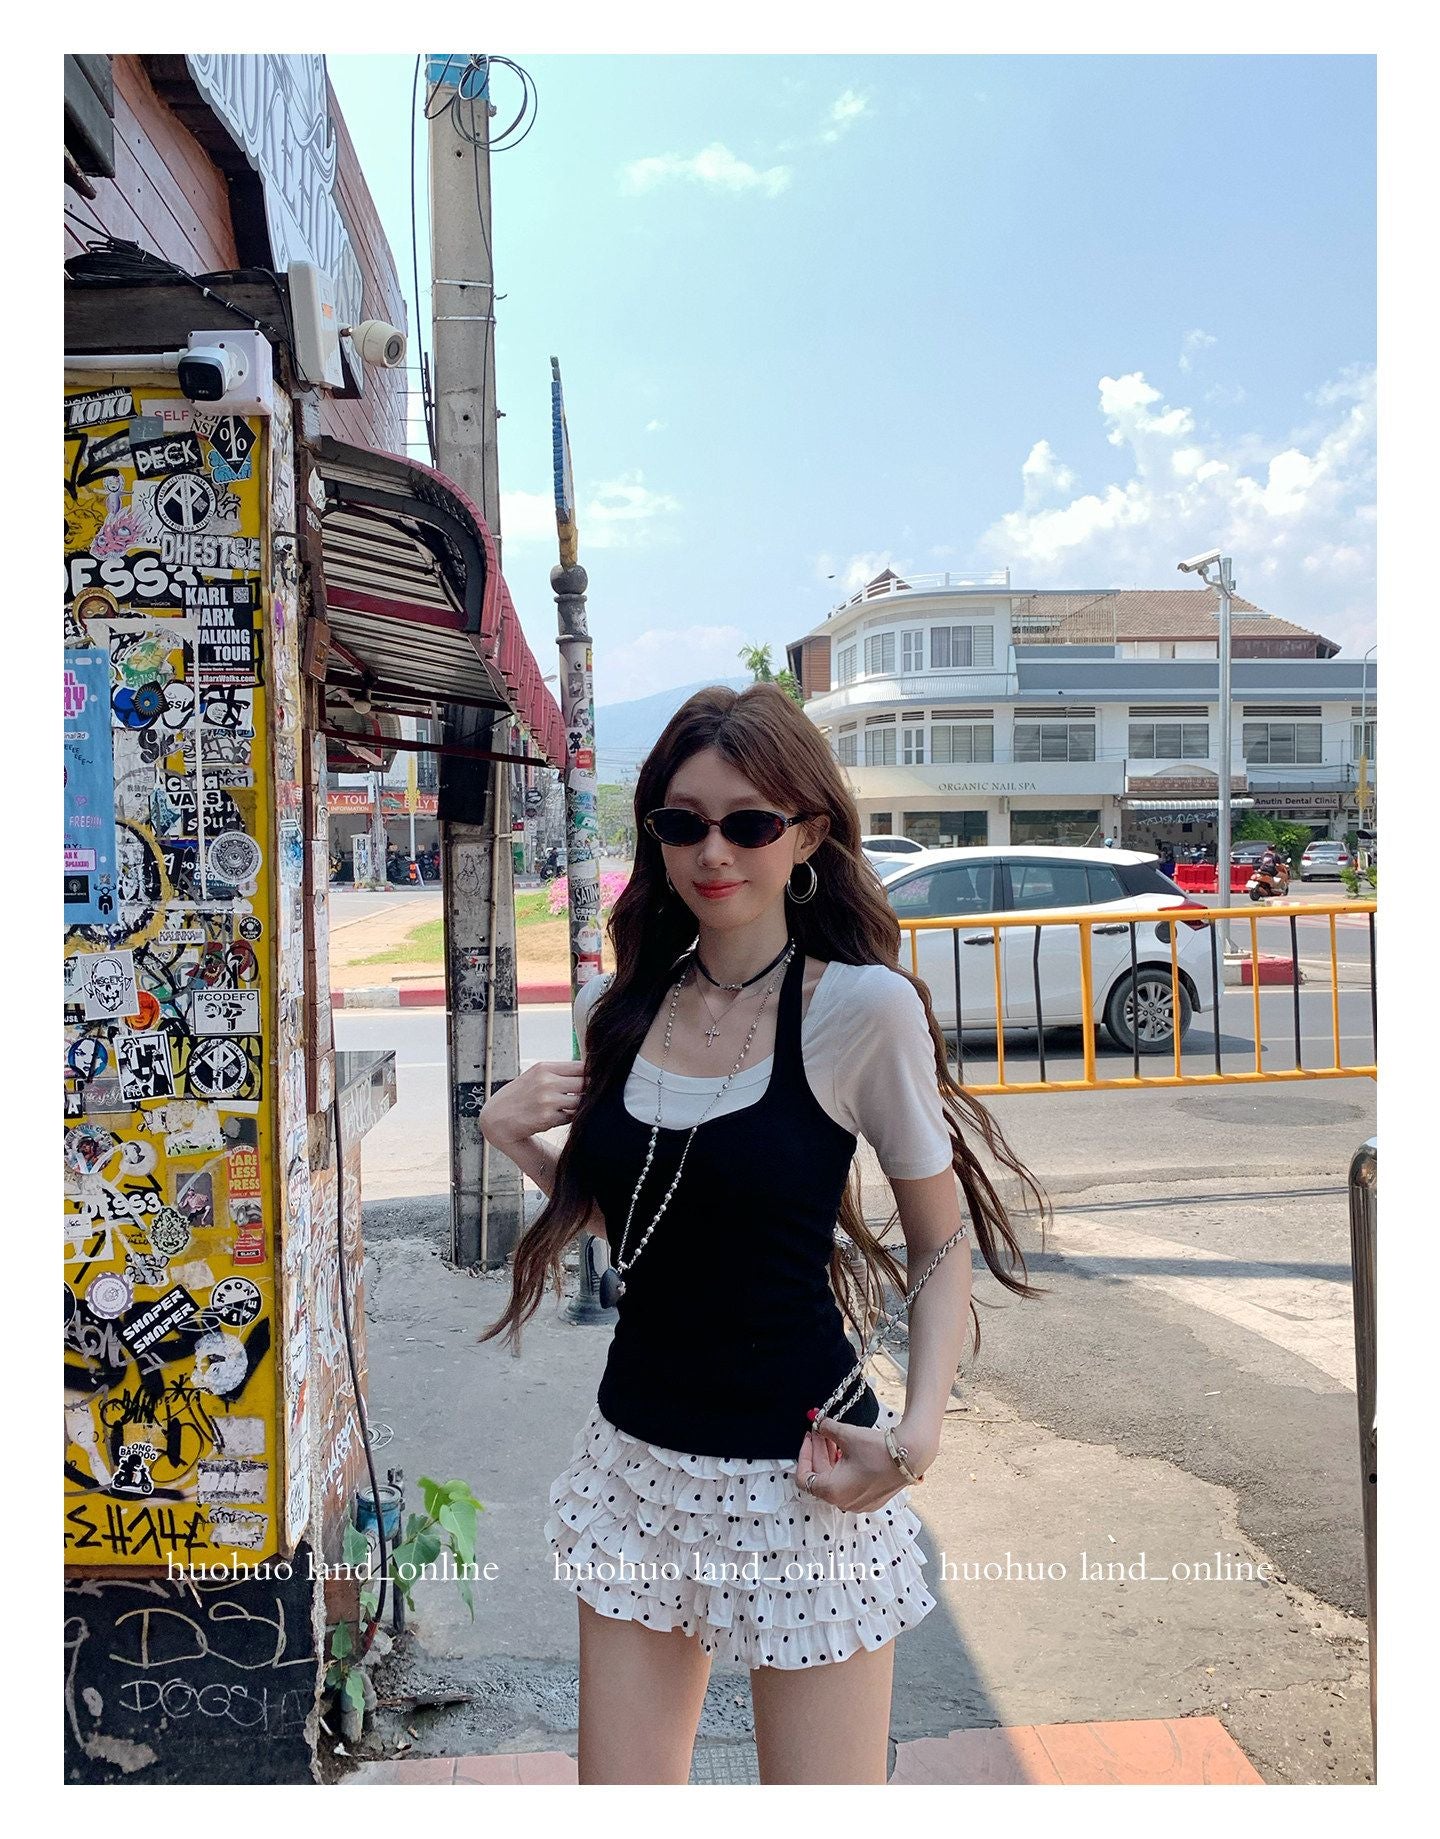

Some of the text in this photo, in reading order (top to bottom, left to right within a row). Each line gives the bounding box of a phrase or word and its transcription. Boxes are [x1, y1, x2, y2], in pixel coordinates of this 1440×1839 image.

[69, 395, 133, 426] KOKO
[155, 410, 189, 420] SELF
[136, 439, 198, 474] DECK
[185, 587, 228, 605] KARL
[198, 629, 250, 645] ALKING
[213, 645, 251, 661] TOUR
[938, 782, 1037, 791] ORGANIC NAIL SPA
[1255, 797, 1337, 805] Anutin Dental Clinic
[197, 992, 255, 1001] #CODEFC
[229, 1154, 258, 1166] CARE
[231, 1167, 257, 1179] LESS
[229, 1179, 260, 1190] PRESS
[122, 1289, 184, 1341] SHAPER
[133, 1302, 195, 1354] SHAPER
